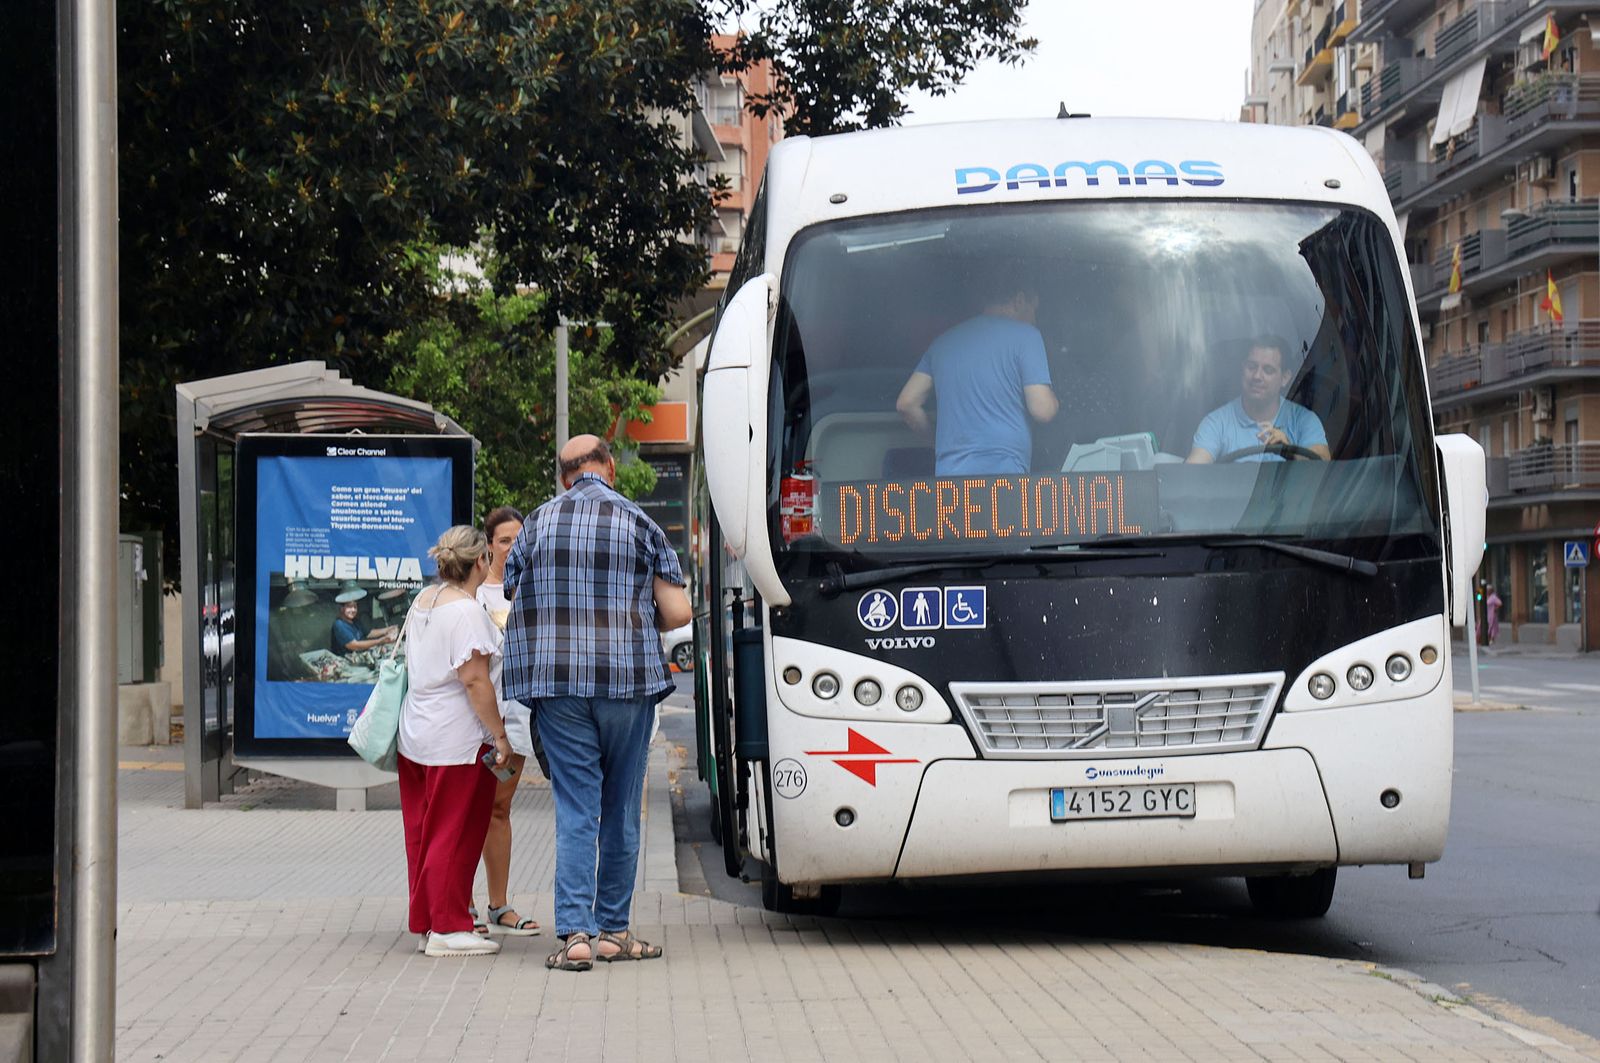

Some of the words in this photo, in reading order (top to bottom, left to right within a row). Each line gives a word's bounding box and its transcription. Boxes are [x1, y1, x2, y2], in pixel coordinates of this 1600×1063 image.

[955, 160, 1225, 195] DAMAS
[337, 447, 356, 456] Clear
[357, 448, 386, 456] Channel
[331, 485, 352, 493] Como
[839, 475, 1142, 544] DISCRECIONAL
[284, 554, 423, 581] HUELVA
[378, 580, 423, 589] Presúmela!
[865, 636, 936, 650] VOLVO
[775, 769, 803, 788] 276
[1068, 790, 1132, 814] 4152
[1143, 788, 1189, 812] GYC
